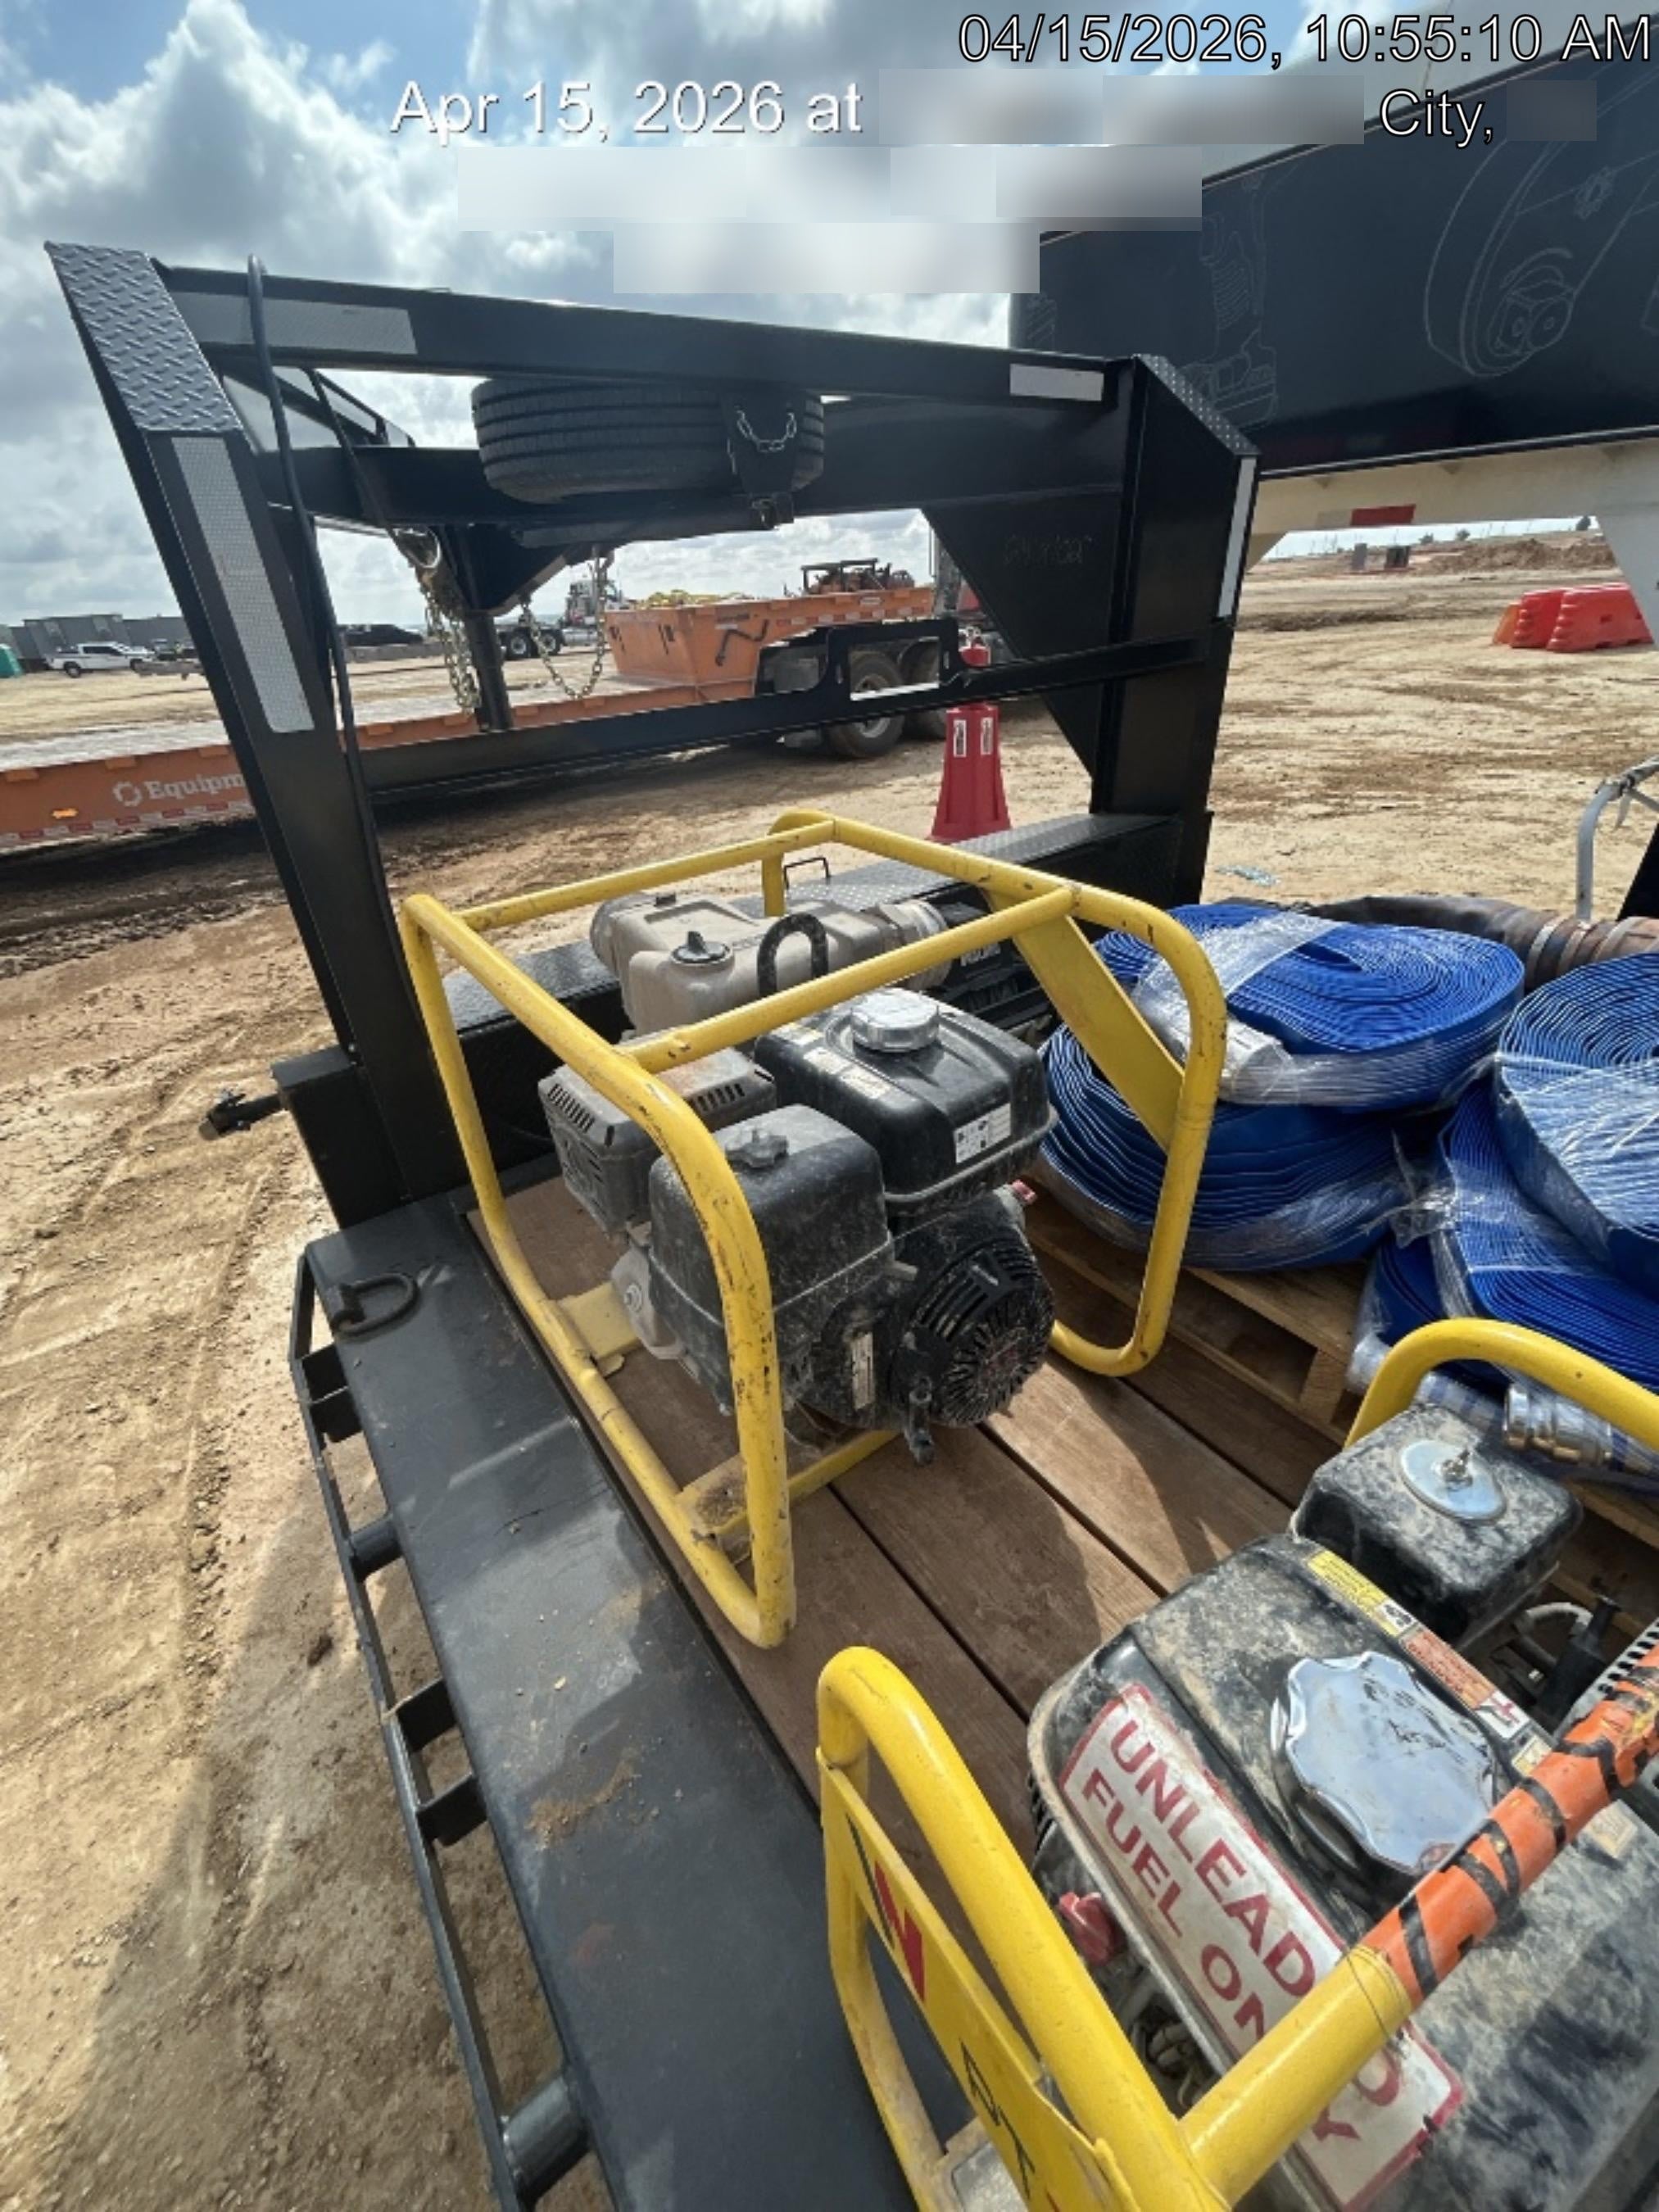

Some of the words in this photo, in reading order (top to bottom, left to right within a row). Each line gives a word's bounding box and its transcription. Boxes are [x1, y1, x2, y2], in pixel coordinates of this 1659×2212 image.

[143, 773, 246, 800] Equipm
[1082, 1769, 1183, 1938] FUEL
[1201, 1945, 1361, 2144] ONY
[1110, 1719, 1403, 2106] UNLEADD
